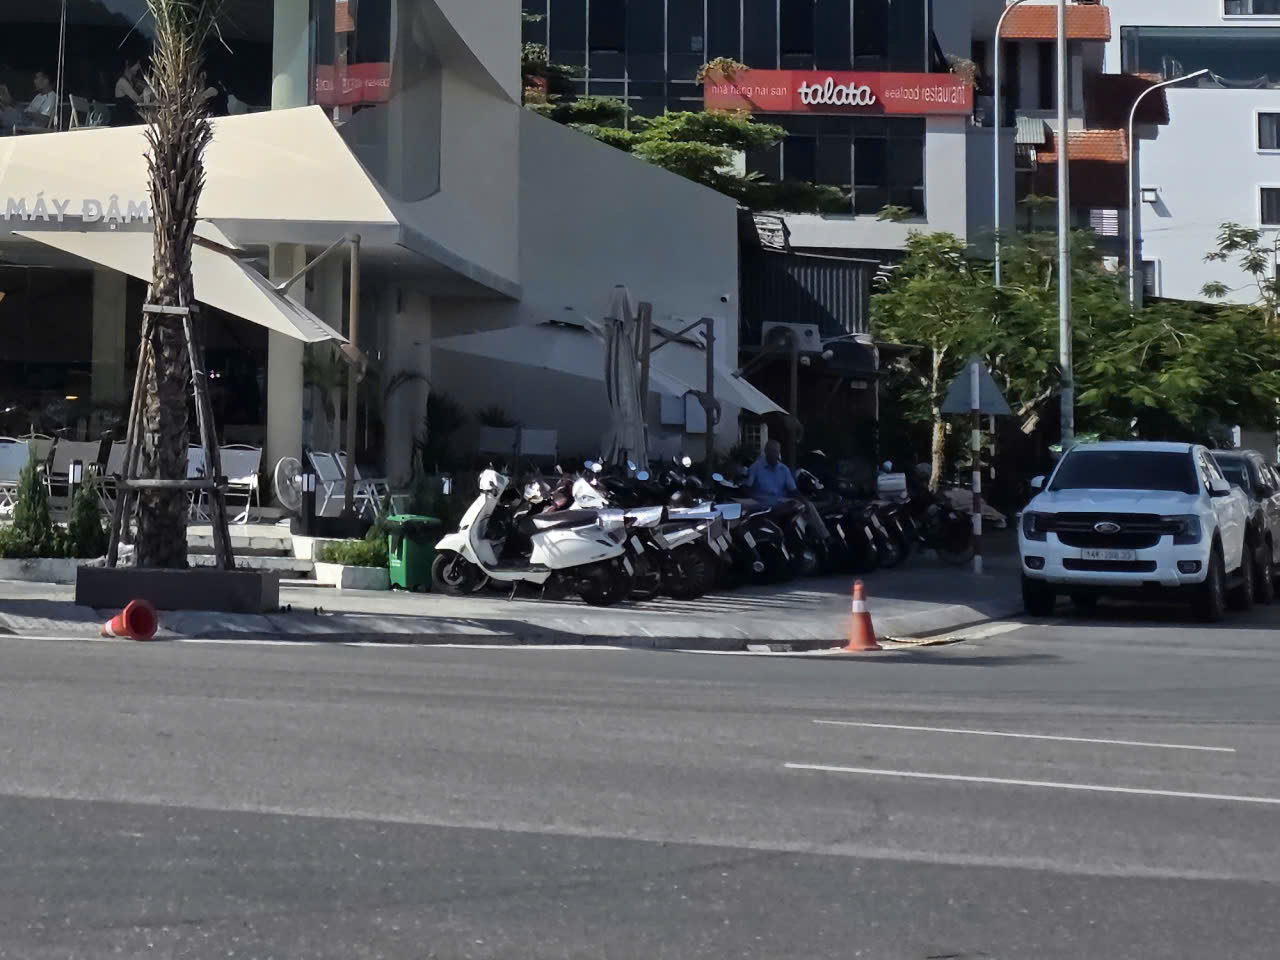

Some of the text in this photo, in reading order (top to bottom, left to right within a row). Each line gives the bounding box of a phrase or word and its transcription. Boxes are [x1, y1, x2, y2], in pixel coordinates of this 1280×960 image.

[798, 77, 876, 106] talata
[884, 83, 965, 105] seafood restaurant
[4, 190, 70, 223] MÁY
